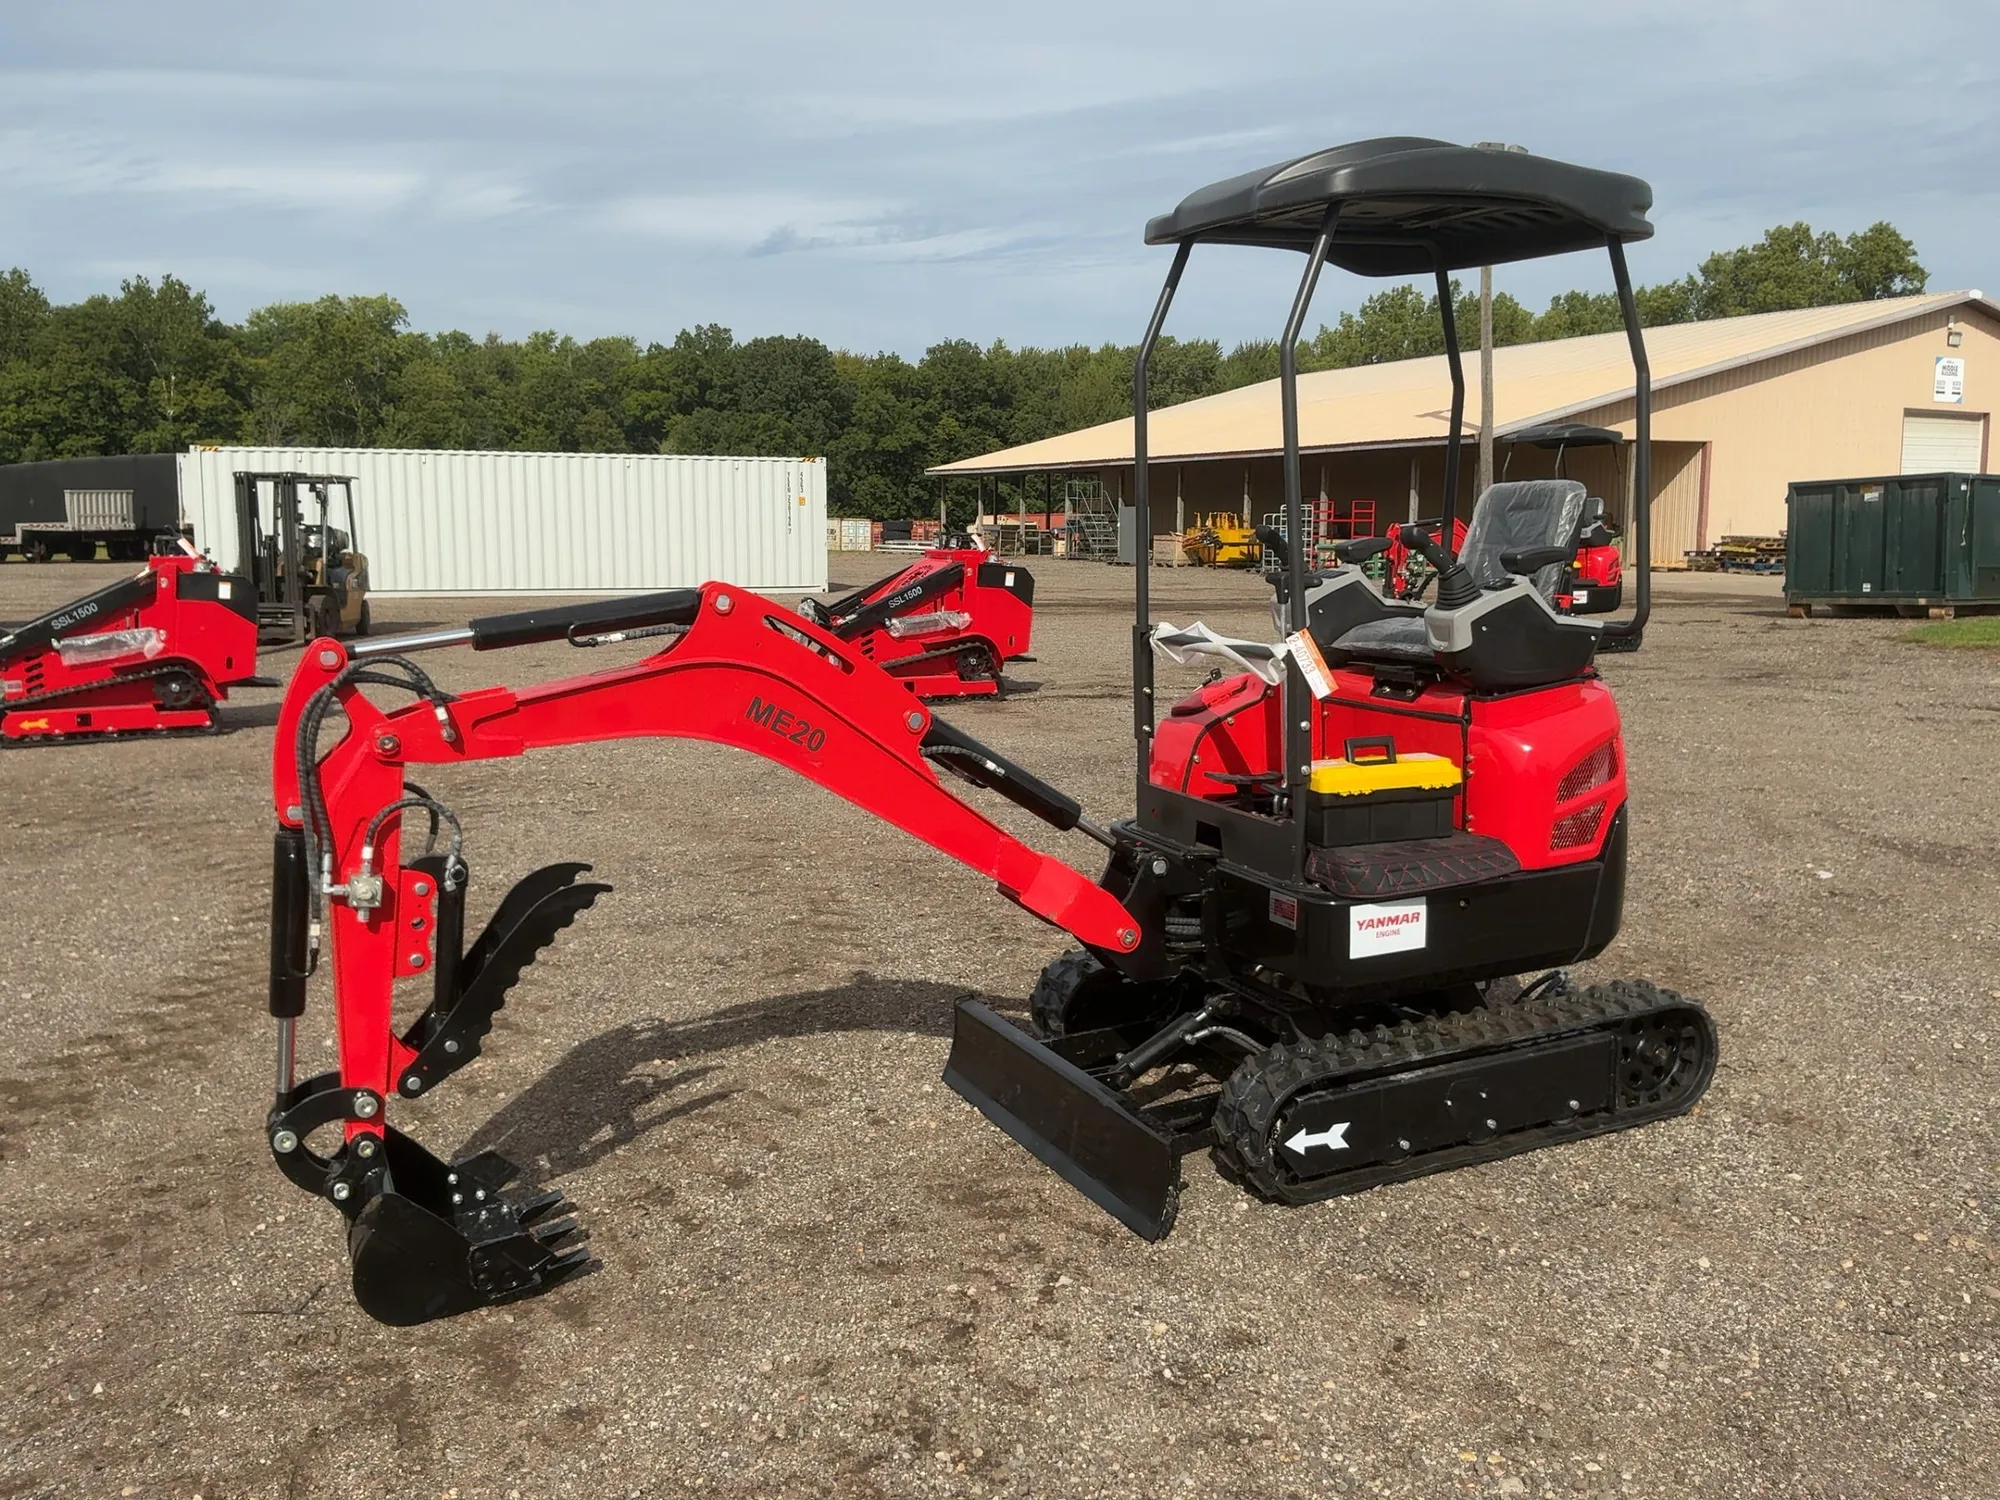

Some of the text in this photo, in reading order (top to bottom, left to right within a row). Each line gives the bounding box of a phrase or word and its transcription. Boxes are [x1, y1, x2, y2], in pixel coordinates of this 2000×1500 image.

[888, 586, 923, 608] SSL1500
[51, 602, 98, 630] SSL1500
[1288, 636, 1316, 675] 2-40733
[745, 696, 826, 752] ME20
[1356, 912, 1421, 931] YANMAR
[1375, 928, 1401, 938] ENGINE
